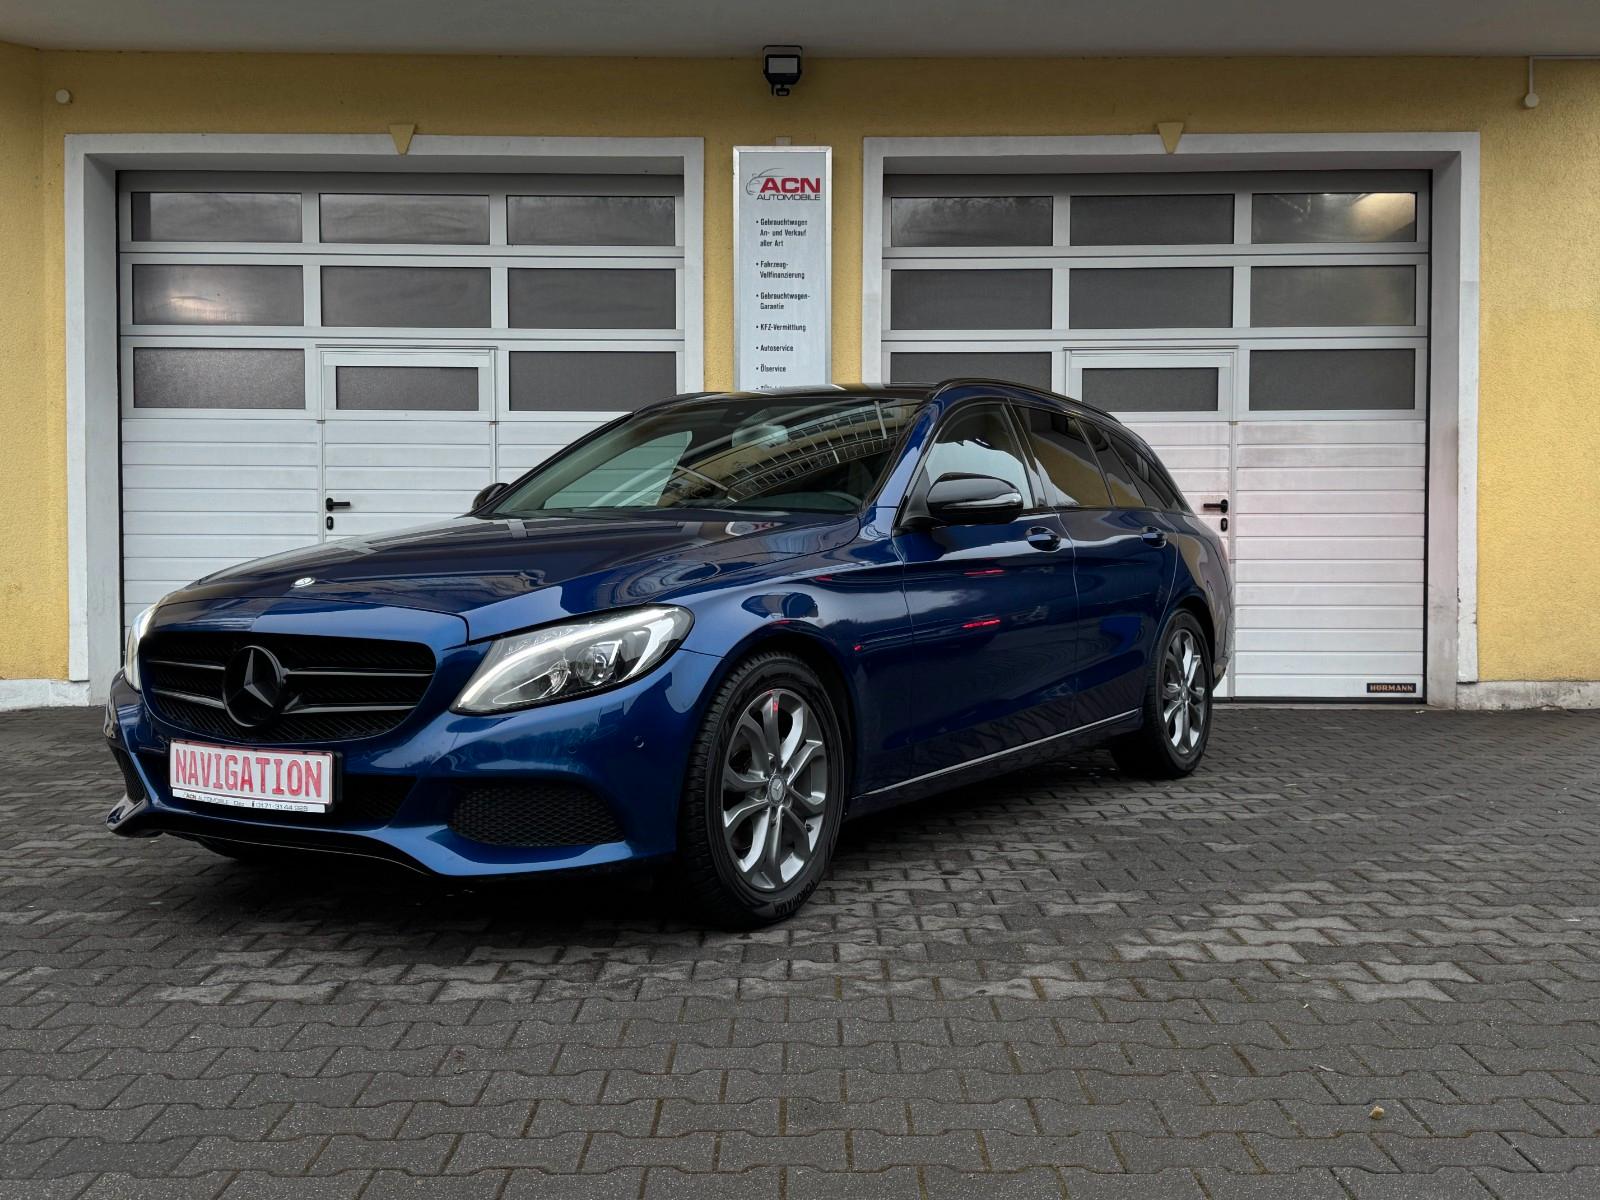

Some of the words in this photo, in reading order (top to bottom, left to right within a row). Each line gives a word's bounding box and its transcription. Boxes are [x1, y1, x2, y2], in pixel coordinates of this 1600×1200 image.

[760, 177, 821, 193] ACN
[760, 218, 808, 227] Gebrauchtwagen
[760, 229, 770, 237] An-
[772, 229, 783, 237] und
[785, 229, 807, 237] Verkauf
[760, 260, 789, 269] Fahrzeug-
[760, 292, 811, 301] Gebrauchtwagen-
[760, 302, 785, 310] Garantie
[760, 323, 807, 332] KFZ-Vermittlung
[760, 344, 794, 352] Autoservice
[760, 363, 787, 372] Ölservice
[175, 748, 322, 798] NAVIGATION
